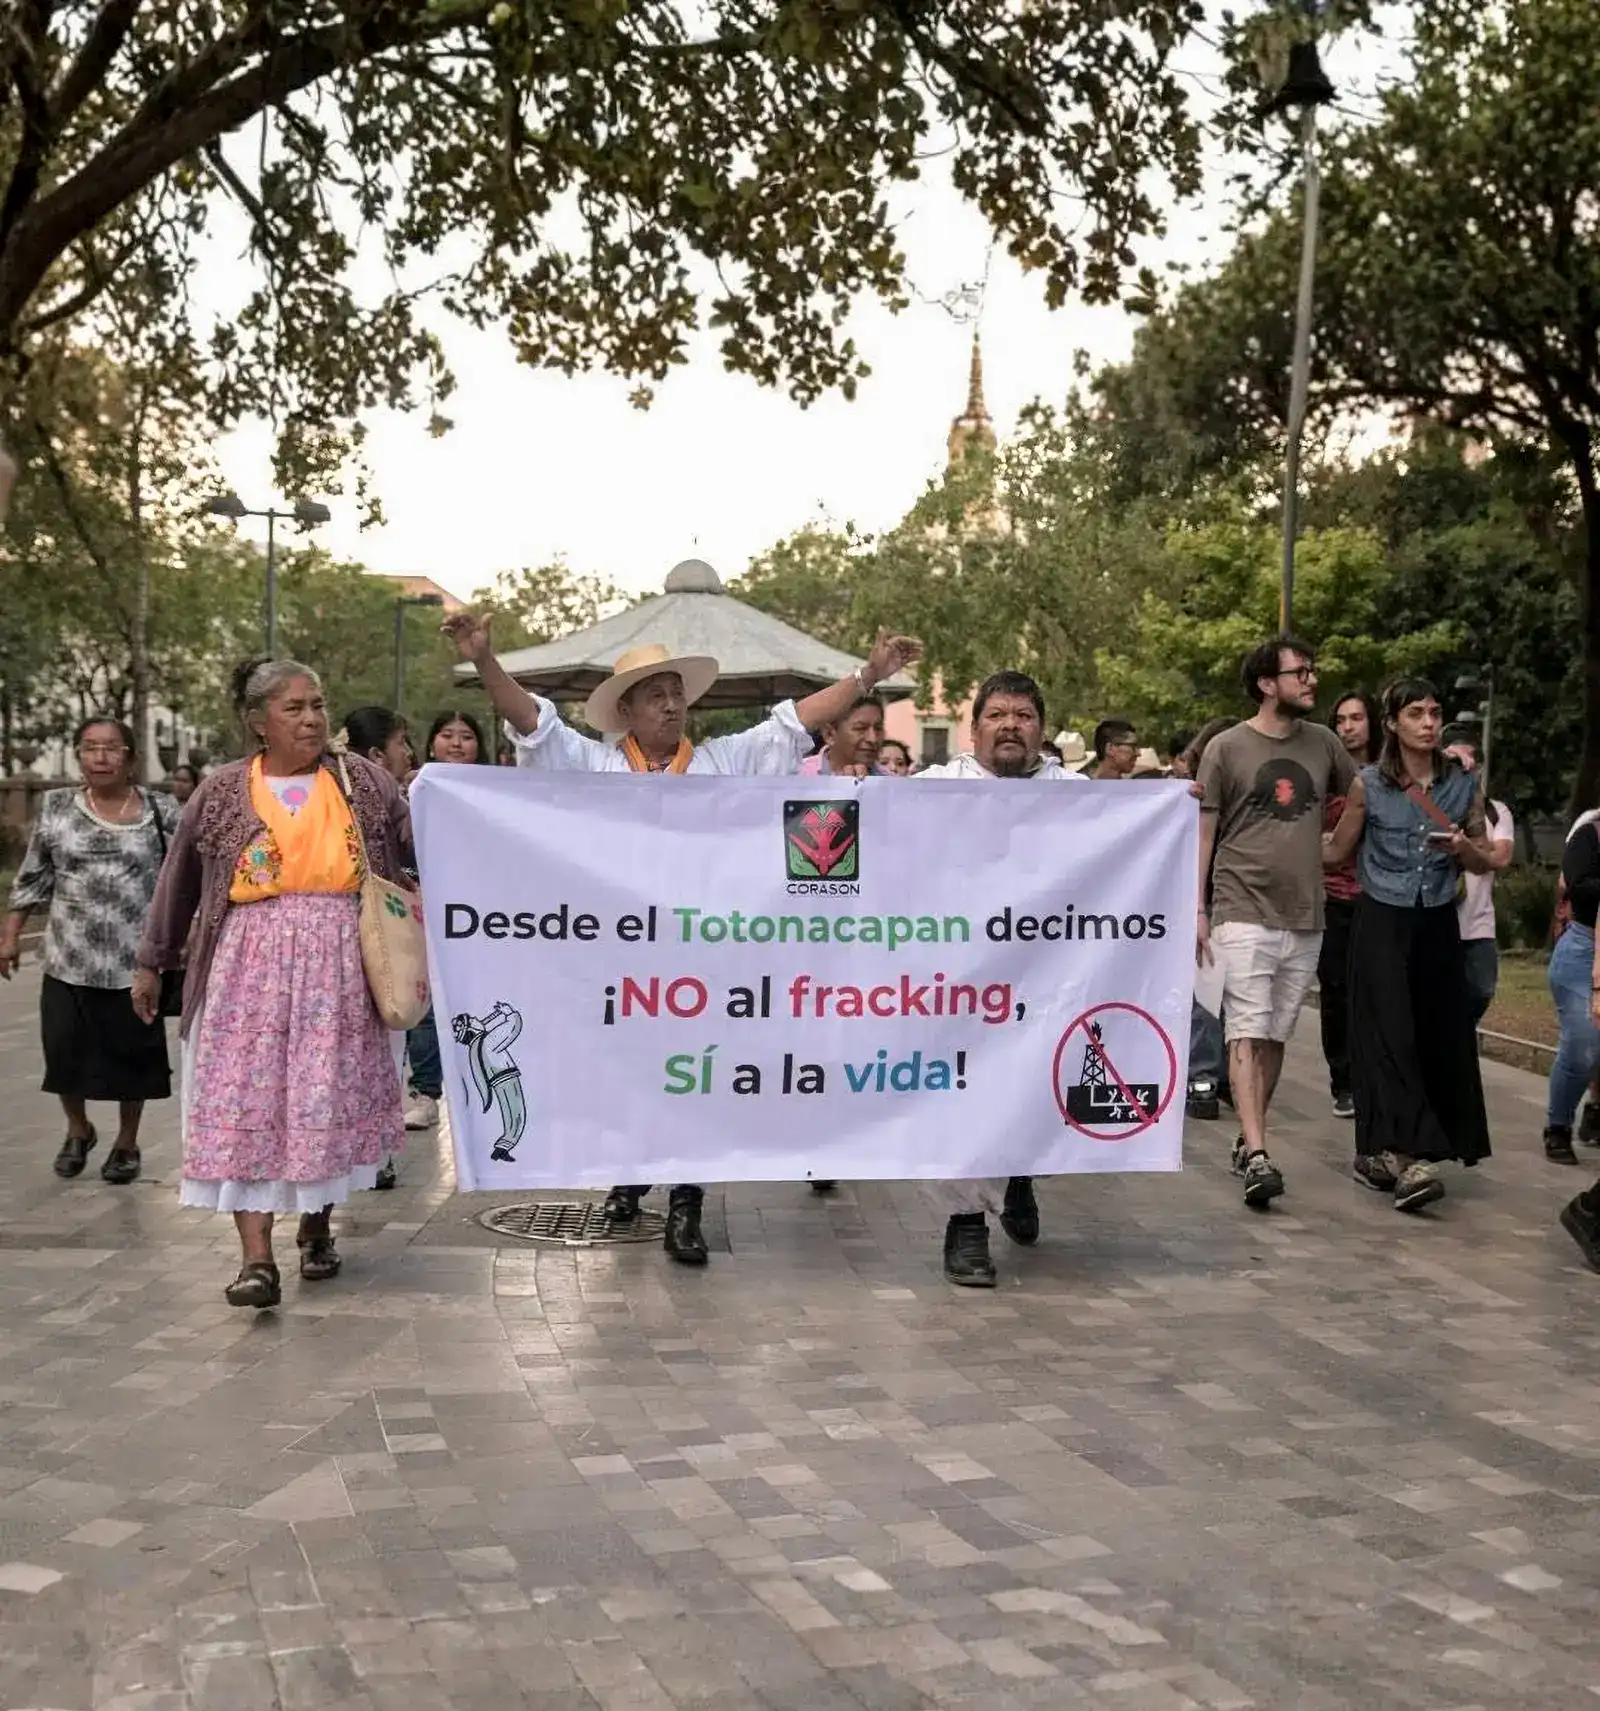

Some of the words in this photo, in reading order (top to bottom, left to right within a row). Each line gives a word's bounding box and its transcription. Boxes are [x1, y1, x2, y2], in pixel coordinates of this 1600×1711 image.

[786, 883, 860, 895] CORASON
[444, 903, 600, 941] Desde
[616, 905, 657, 942] el
[673, 908, 971, 951] Totonacapan
[985, 904, 1167, 942] decimos
[604, 976, 709, 1025] ¡NO
[726, 975, 771, 1018] al
[788, 972, 1026, 1024] fracking,
[664, 1044, 719, 1095] SÍ
[732, 1064, 761, 1095] a
[782, 1053, 825, 1095] la
[843, 1050, 967, 1093] vida!
